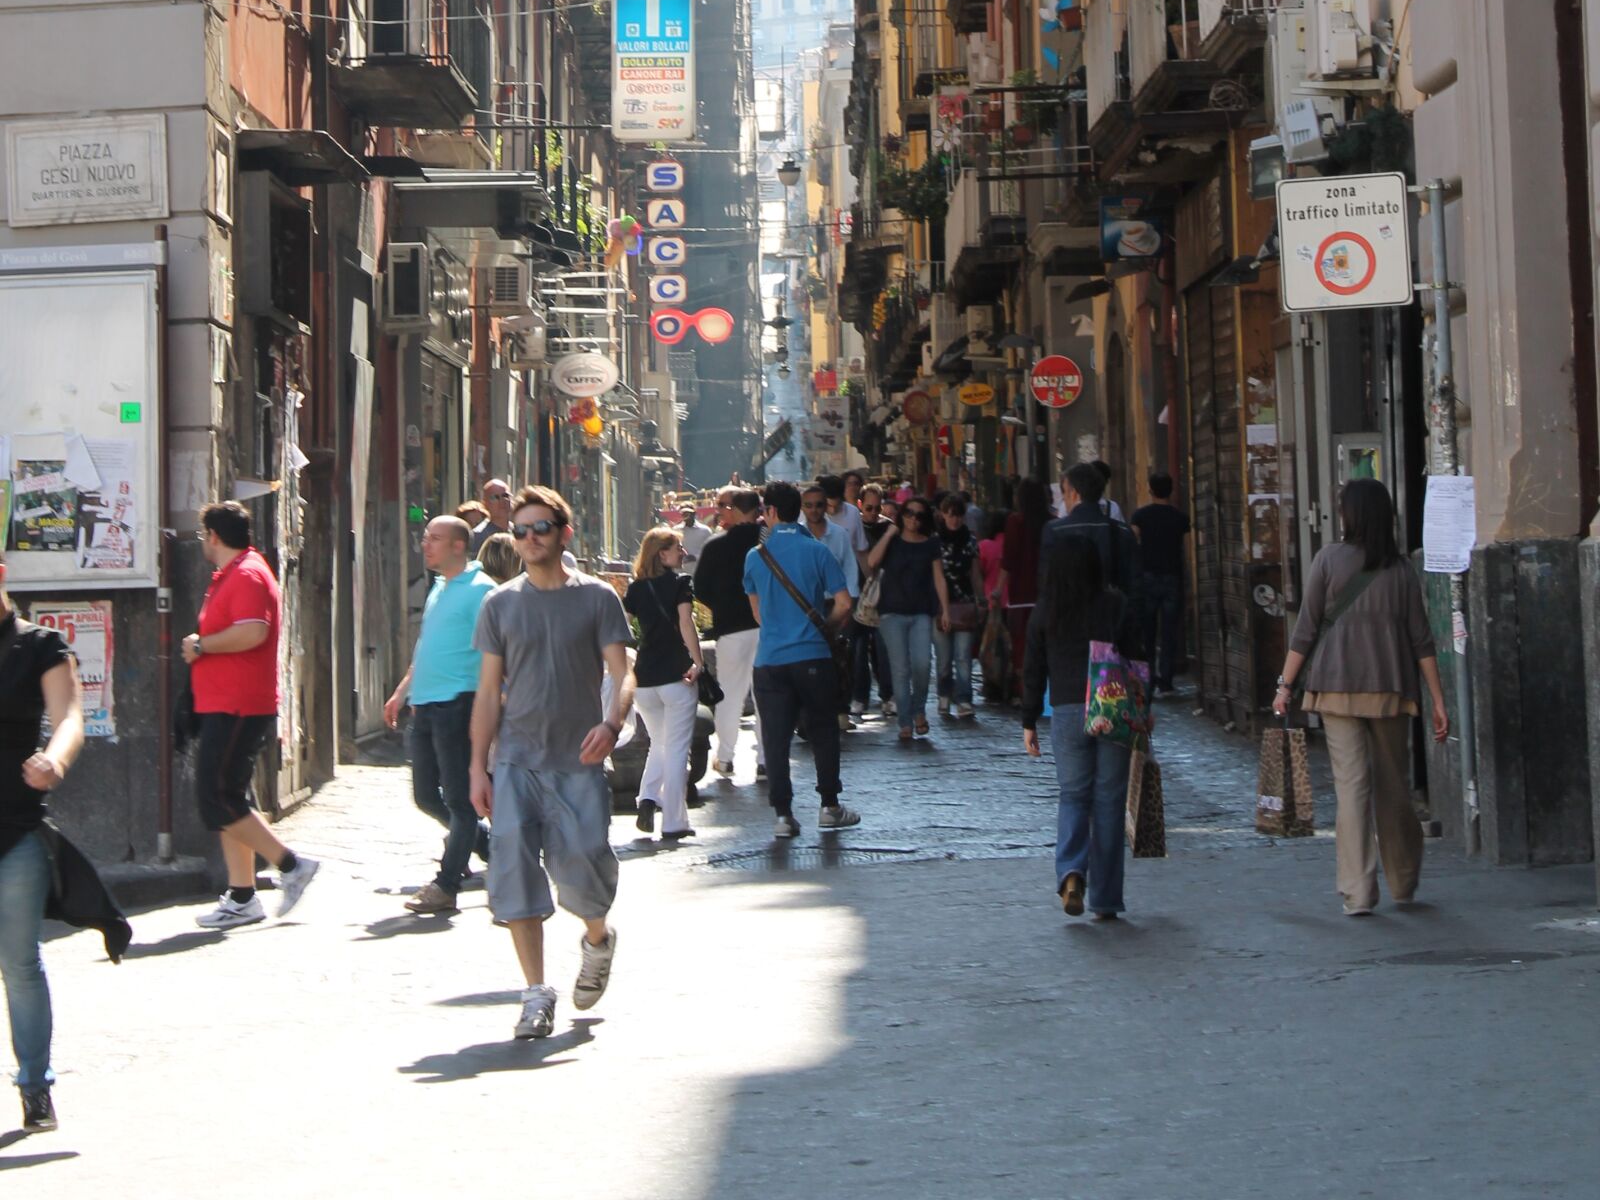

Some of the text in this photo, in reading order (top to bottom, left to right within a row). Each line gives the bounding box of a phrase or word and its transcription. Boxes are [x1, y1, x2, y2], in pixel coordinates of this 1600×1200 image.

[617, 41, 688, 51] VALORI BOLLATI
[622, 57, 683, 67] BOLLO AUTO
[622, 69, 682, 79] CANONE RAI
[59, 143, 113, 161] PIAZZA
[87, 163, 136, 182] NUOVO
[1326, 186, 1357, 199] zona
[1285, 200, 1400, 221] traffico limitato
[653, 166, 681, 337] SACCO
